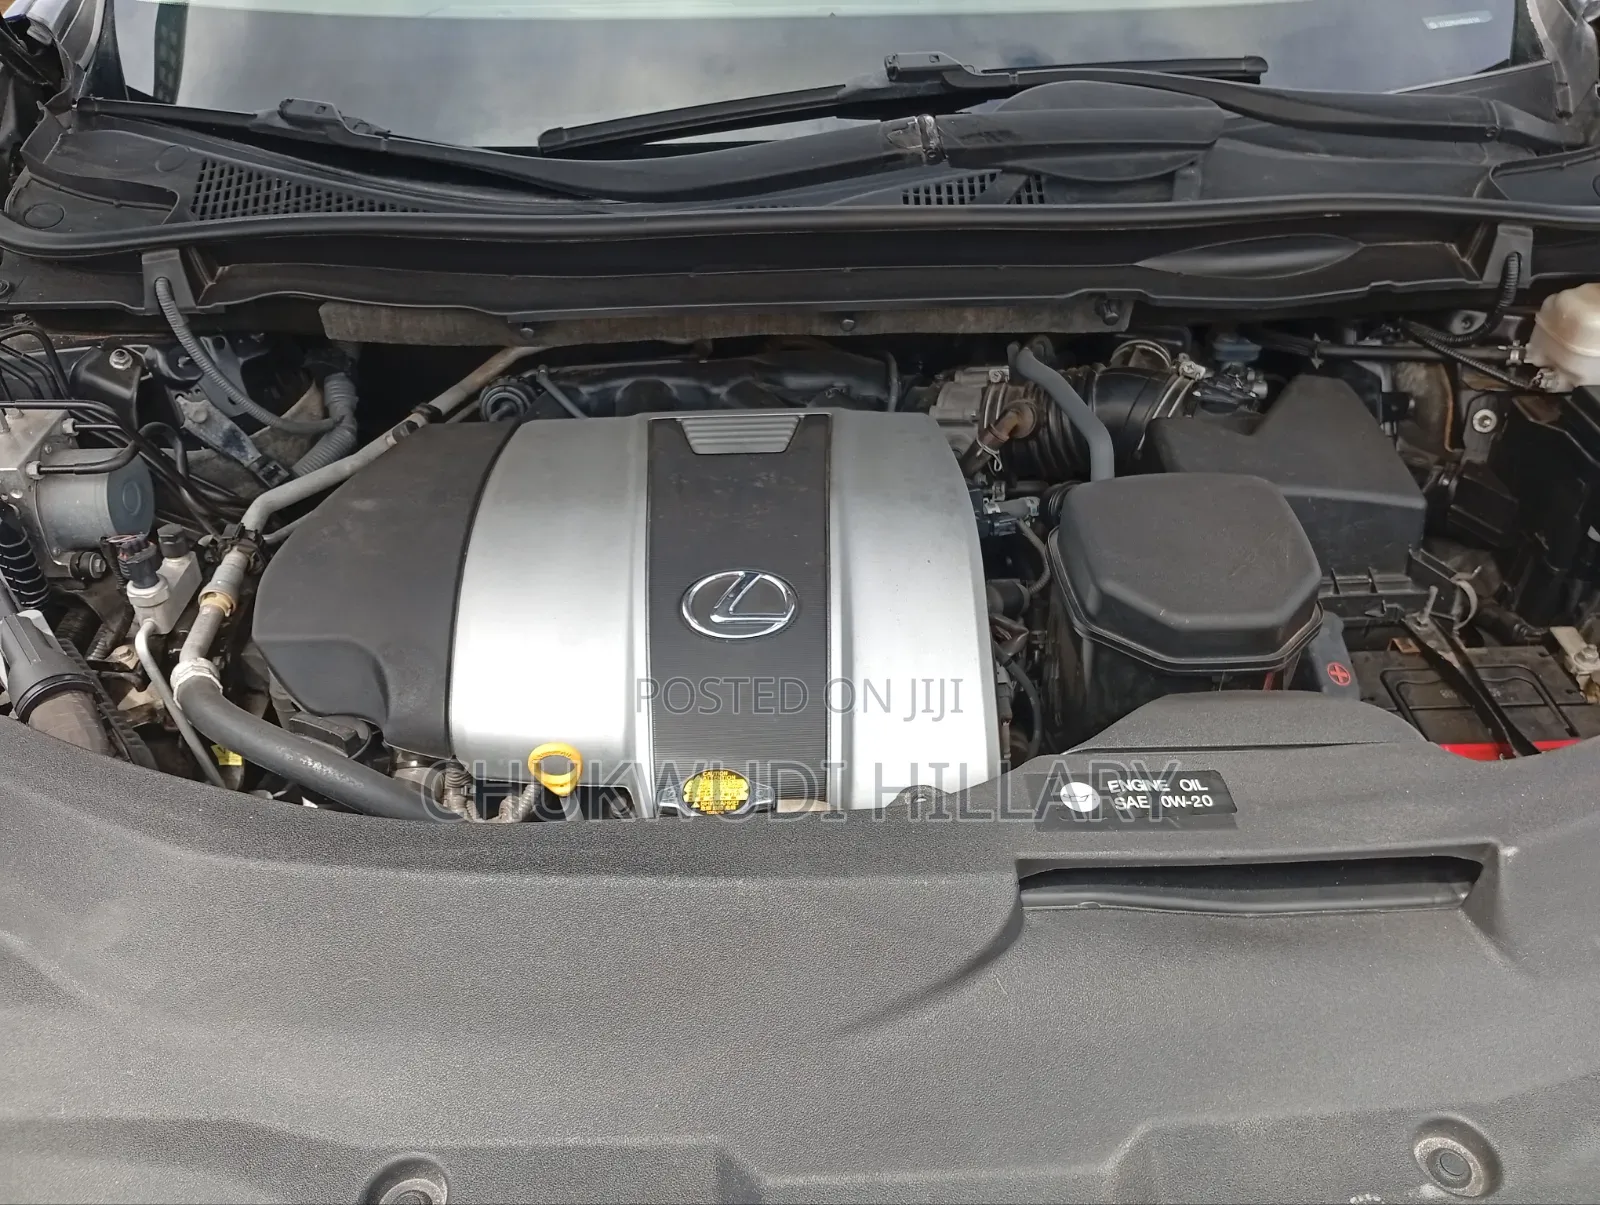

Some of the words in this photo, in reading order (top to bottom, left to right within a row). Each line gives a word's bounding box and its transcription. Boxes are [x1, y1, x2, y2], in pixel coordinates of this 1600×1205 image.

[1107, 779, 1170, 793] ENGINE
[1179, 778, 1209, 792] OIL
[1114, 795, 1150, 810] SAE
[1160, 794, 1213, 809] 0W-20
